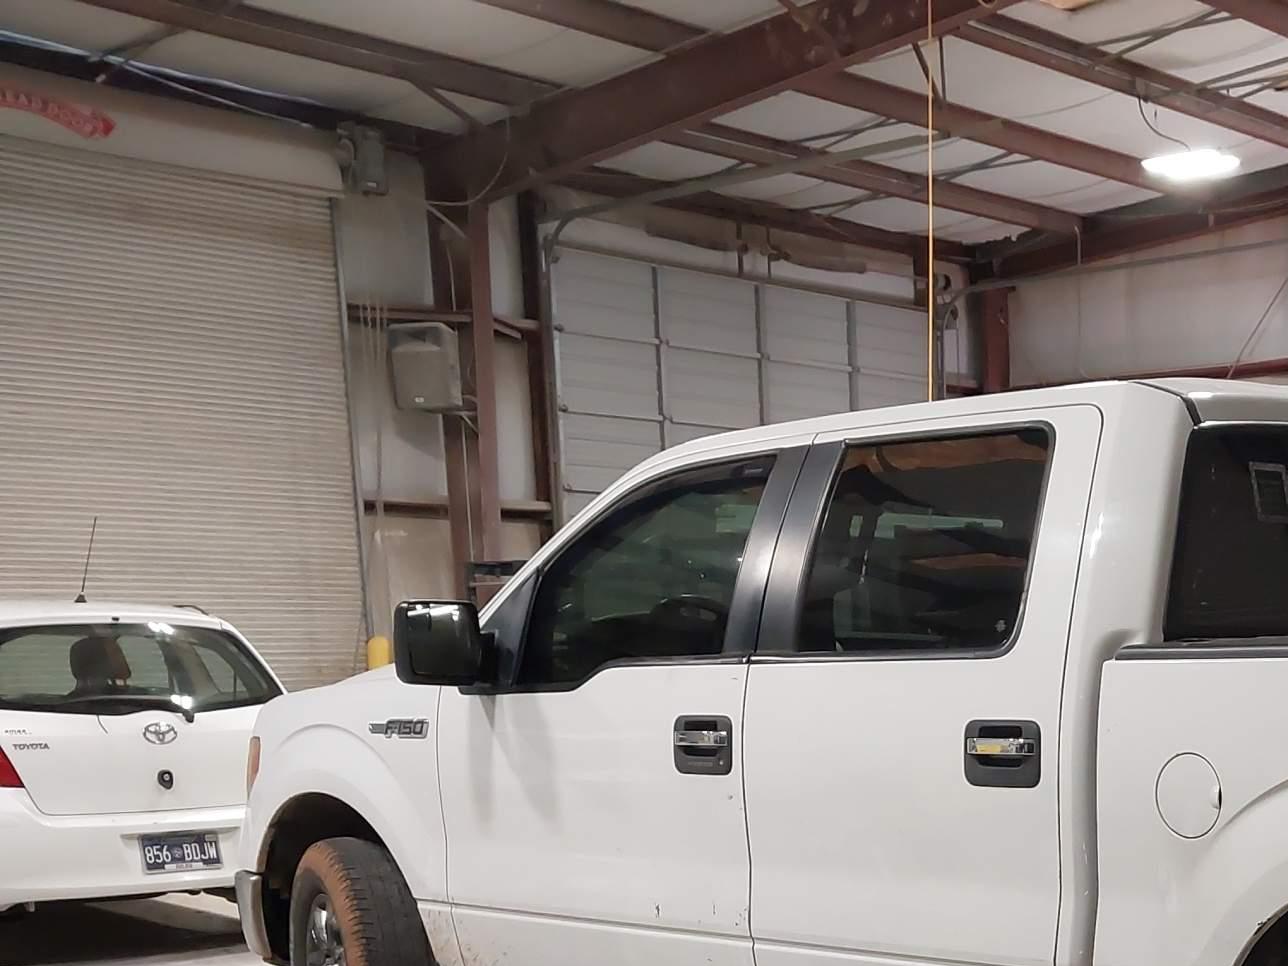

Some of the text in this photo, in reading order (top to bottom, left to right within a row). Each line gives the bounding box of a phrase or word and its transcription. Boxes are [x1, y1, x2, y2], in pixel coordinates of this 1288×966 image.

[11, 742, 51, 751] TOYOTA
[144, 841, 217, 864] 856 BDJW
